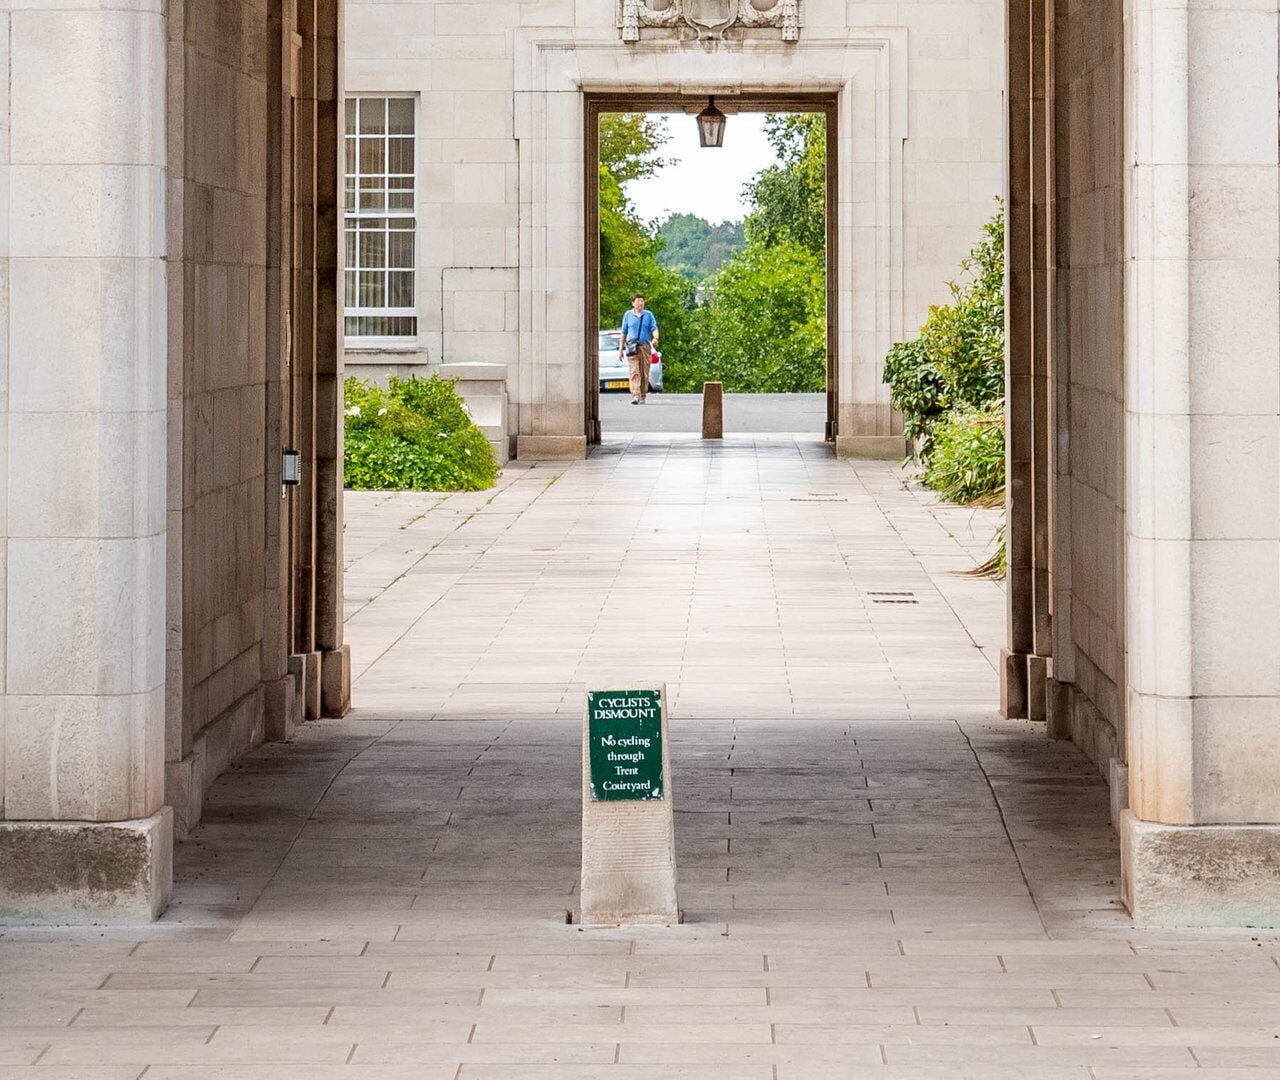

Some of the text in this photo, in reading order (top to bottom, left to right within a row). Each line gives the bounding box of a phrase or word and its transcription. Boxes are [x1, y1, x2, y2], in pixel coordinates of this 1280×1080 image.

[598, 697, 651, 708] CYCLISTS
[594, 708, 656, 720] DISMOUNT
[601, 735, 651, 748] No cycling
[607, 751, 645, 763] through
[614, 766, 639, 776] Trent
[602, 780, 651, 792] Courtyard
